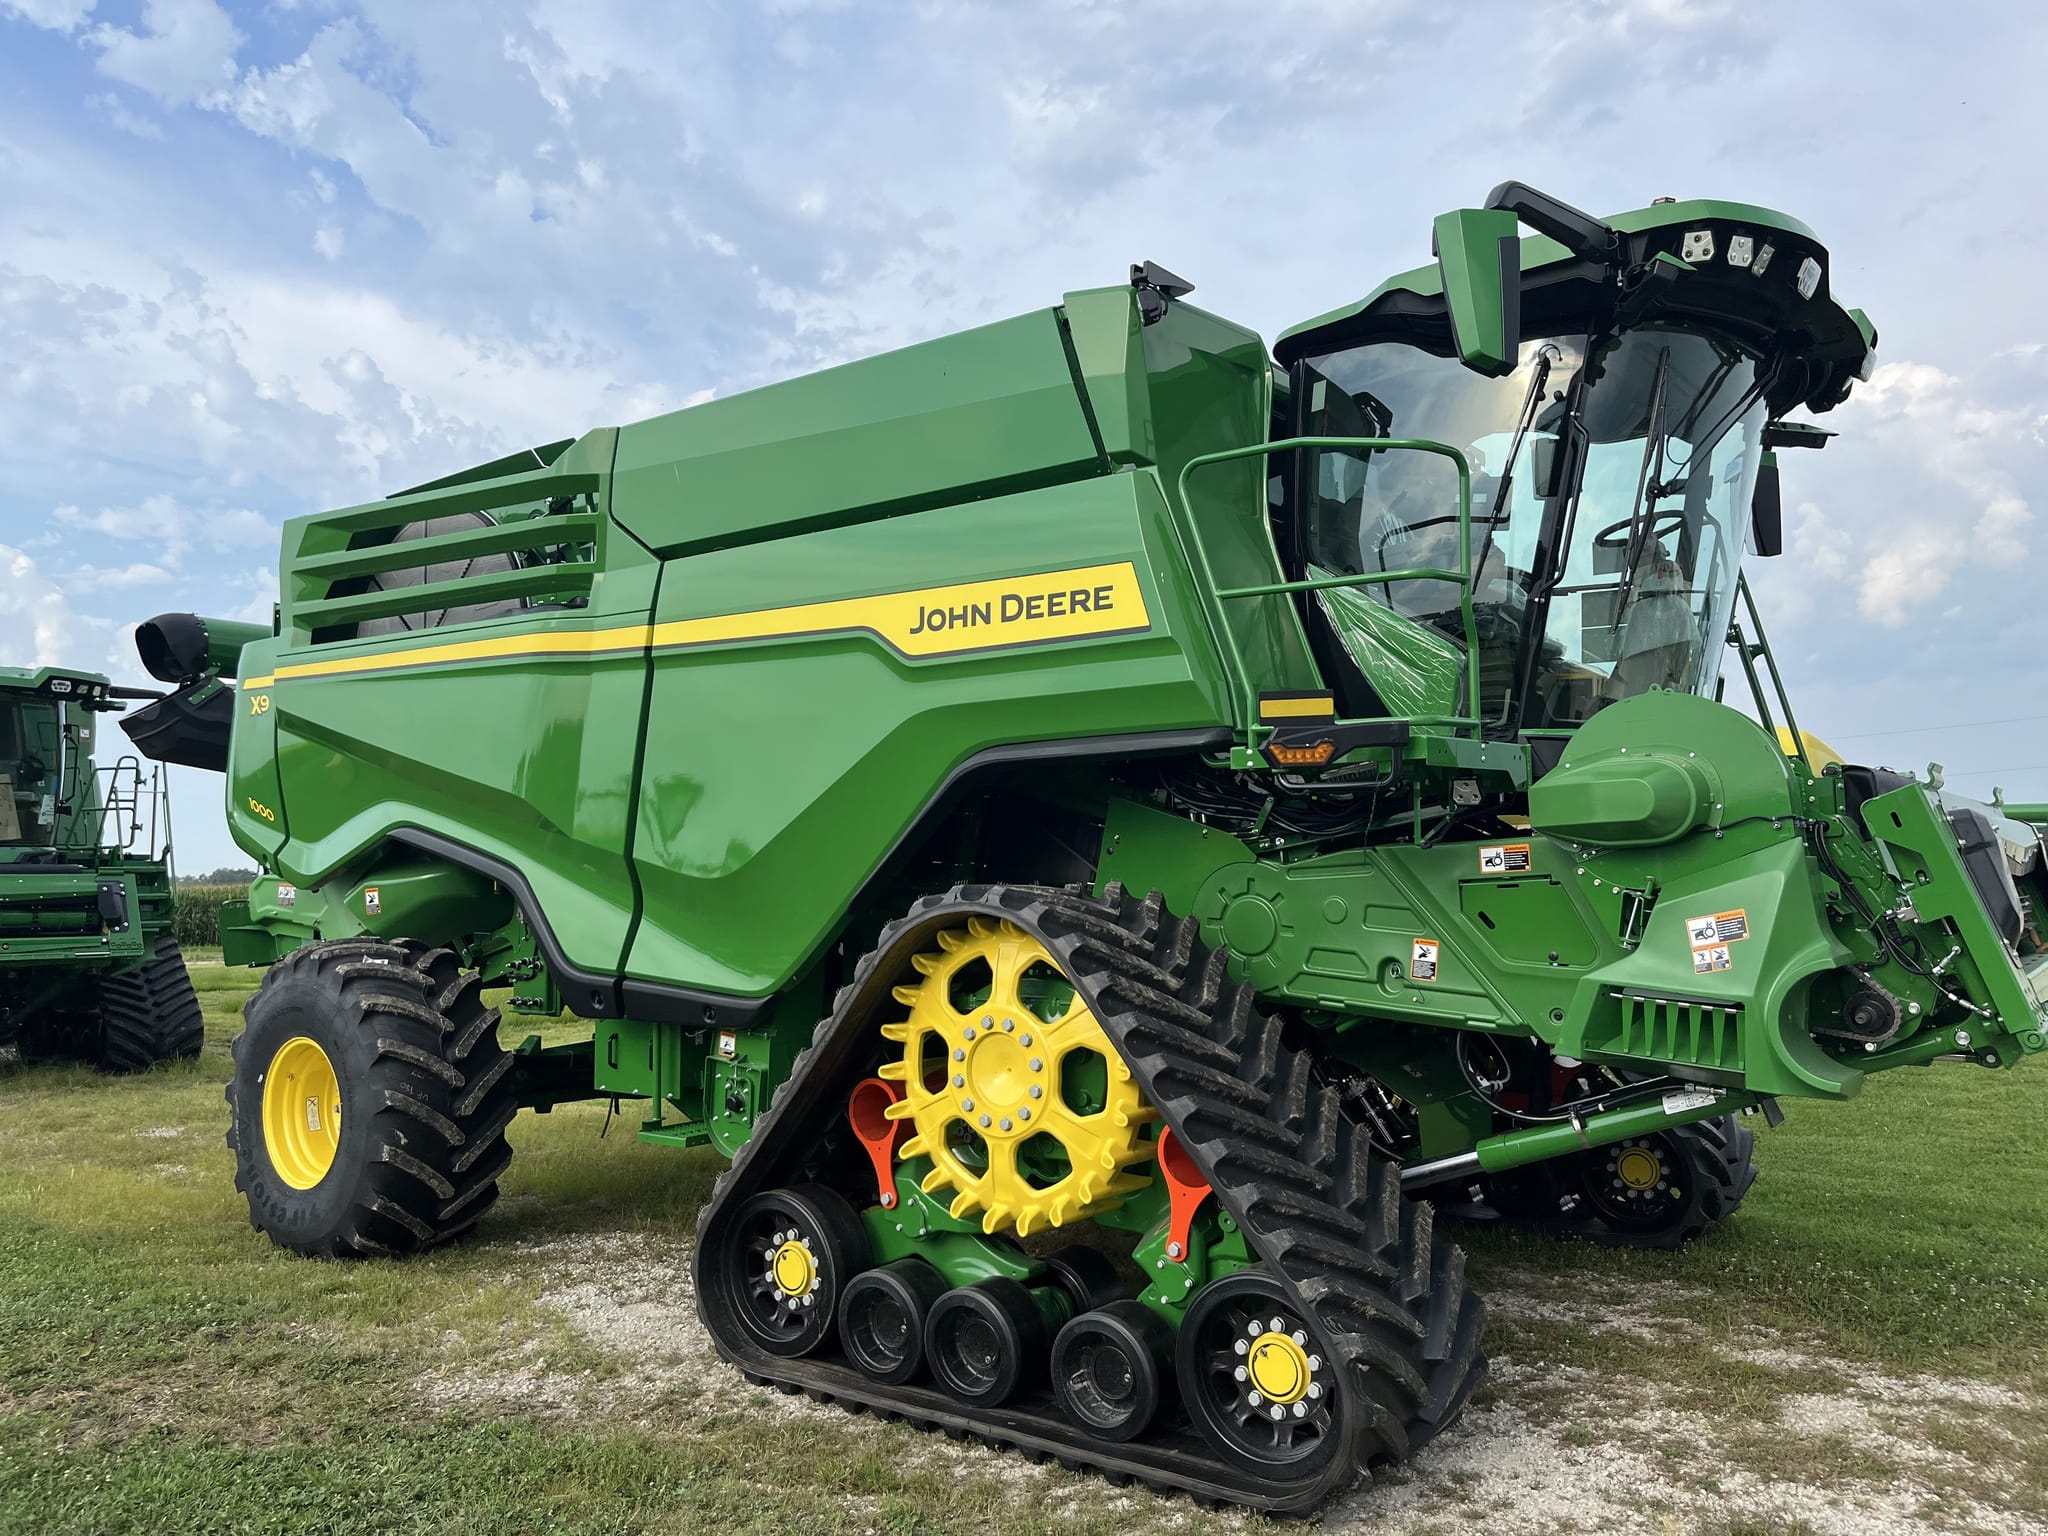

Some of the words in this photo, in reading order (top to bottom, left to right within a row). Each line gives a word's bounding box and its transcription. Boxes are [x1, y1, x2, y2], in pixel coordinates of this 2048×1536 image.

[909, 602, 992, 635] JOHN
[1000, 585, 1114, 623] DEERE
[250, 695, 270, 715] X9
[248, 797, 275, 822] 1000
